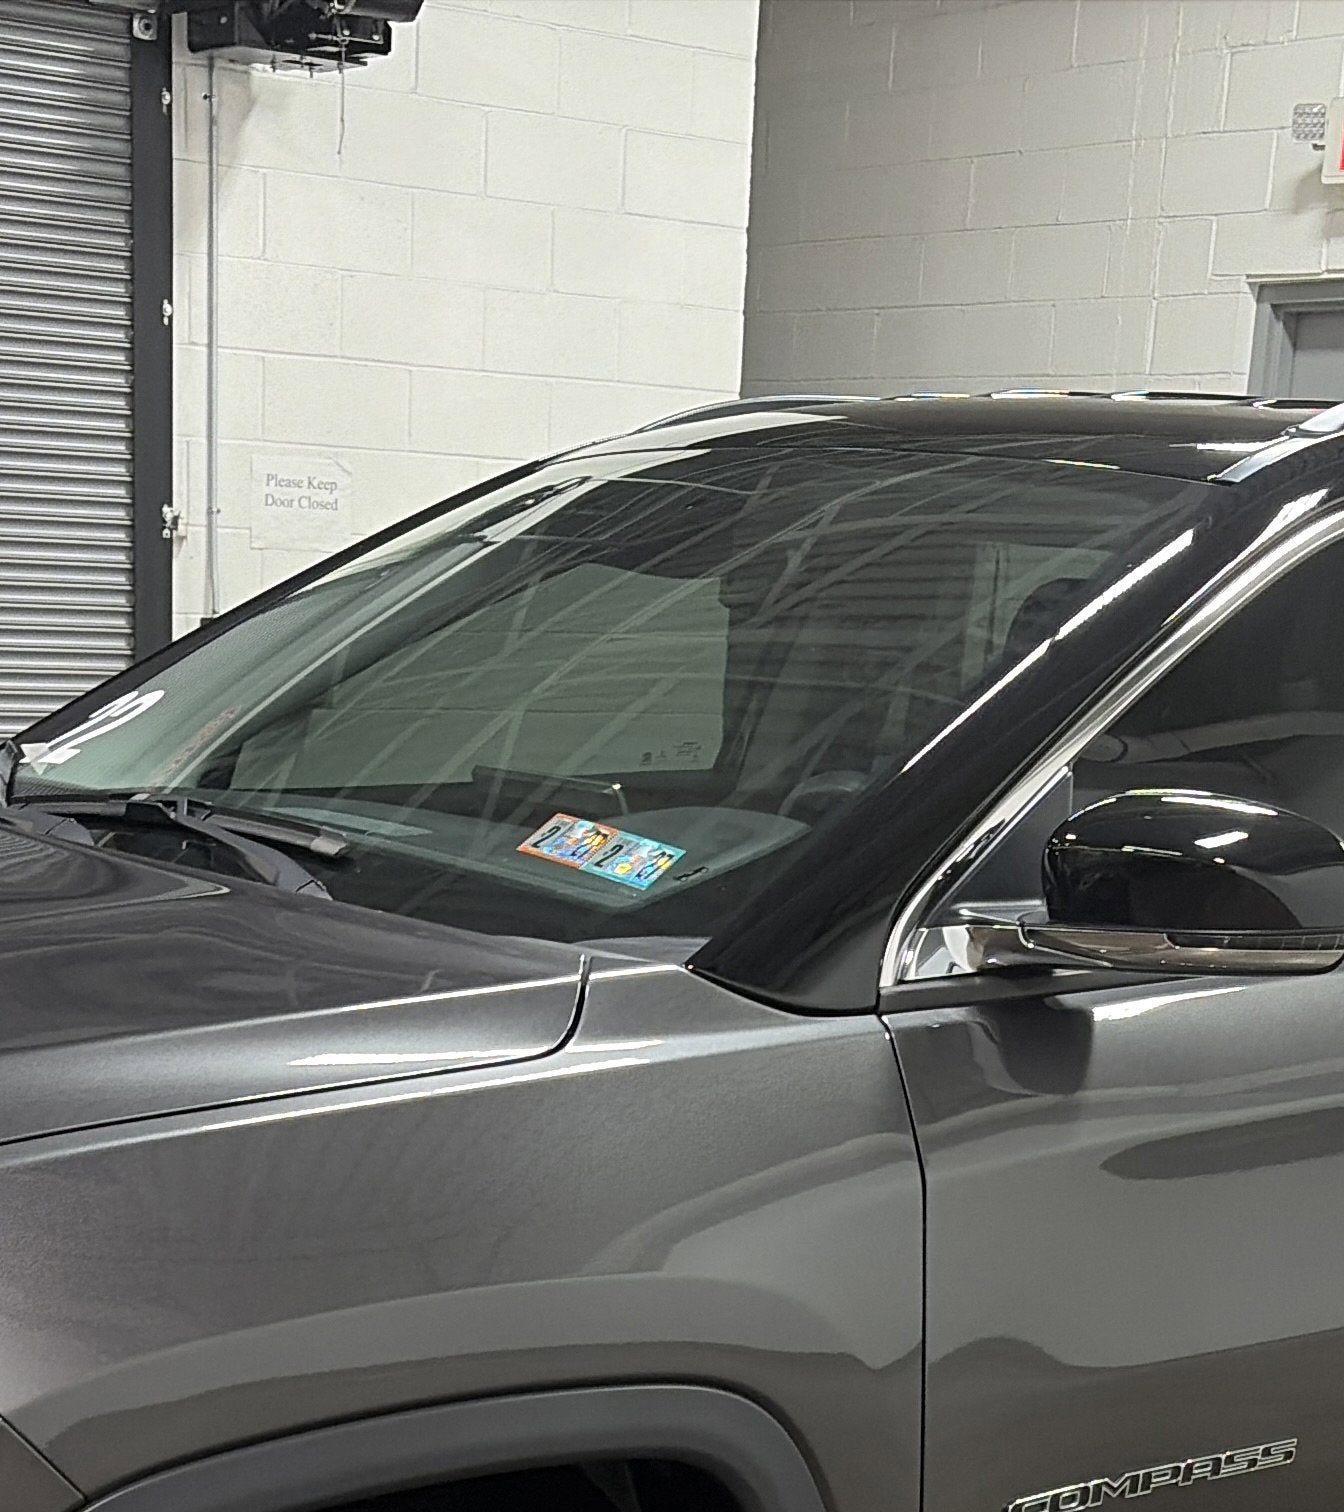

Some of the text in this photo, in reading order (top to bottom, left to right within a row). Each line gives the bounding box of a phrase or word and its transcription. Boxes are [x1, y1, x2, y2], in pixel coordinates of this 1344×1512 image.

[265, 473, 338, 495] Please Keep
[264, 493, 339, 511] Door Closed
